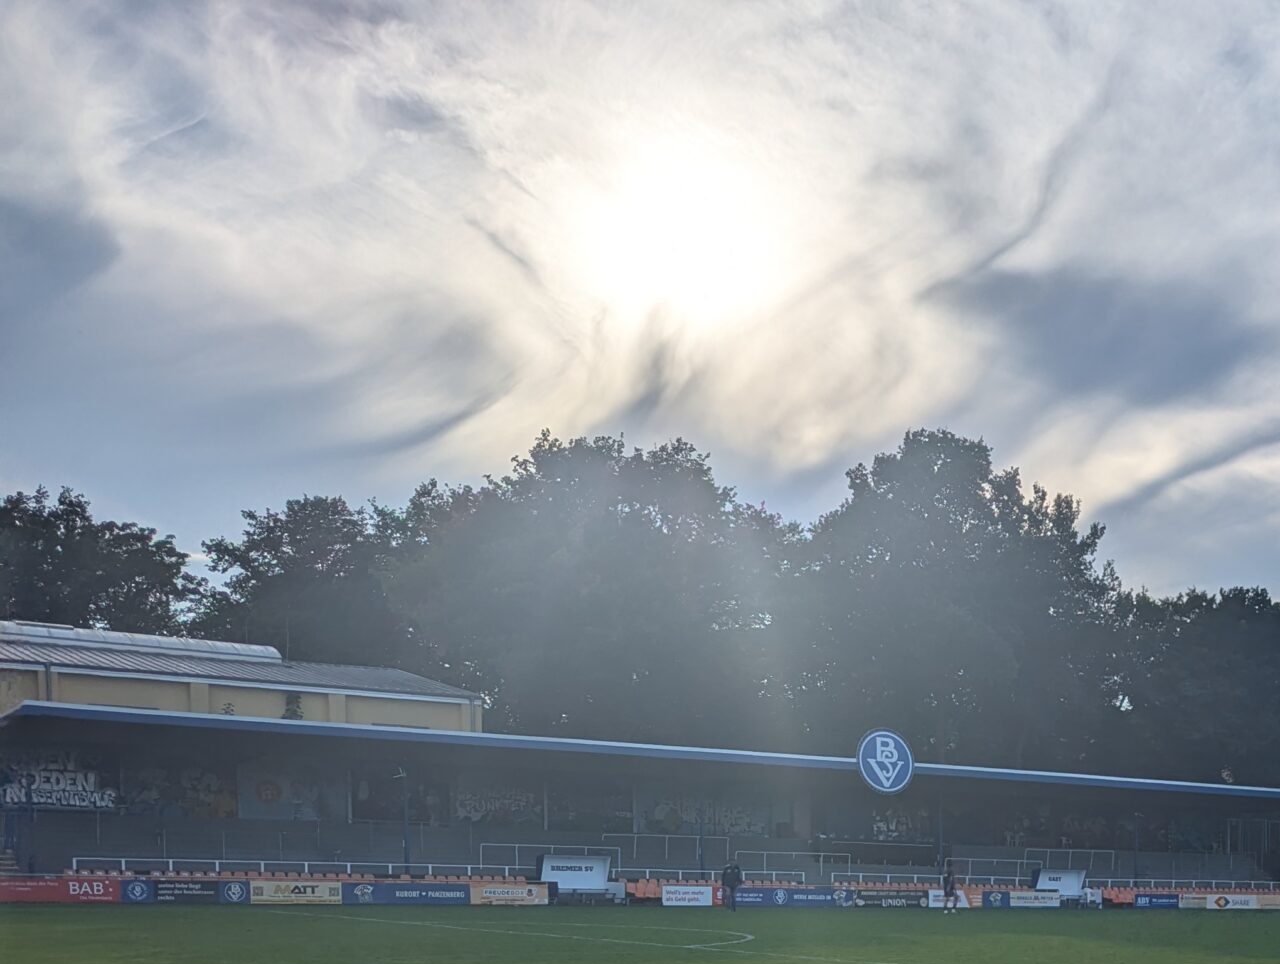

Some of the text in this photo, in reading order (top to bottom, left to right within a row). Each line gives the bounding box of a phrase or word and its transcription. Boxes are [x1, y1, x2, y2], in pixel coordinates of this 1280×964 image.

[867, 737, 904, 787] BSV
[69, 882, 104, 895] BAB
[396, 890, 420, 898] KURORT
[882, 899, 906, 907] UNION
